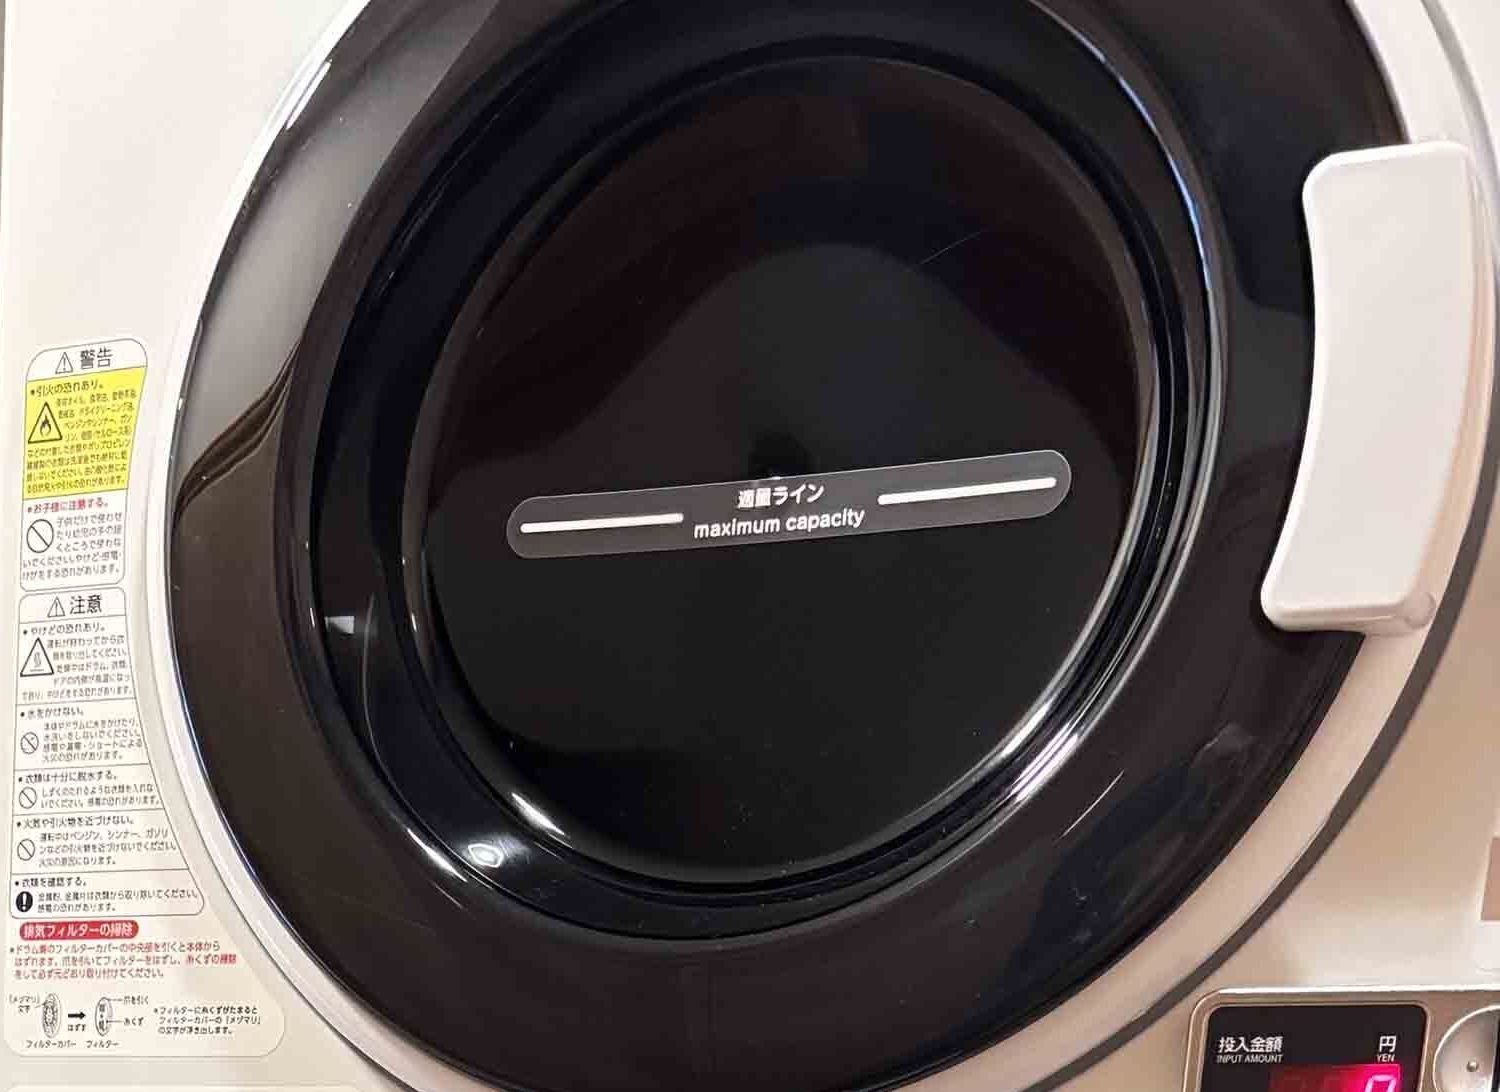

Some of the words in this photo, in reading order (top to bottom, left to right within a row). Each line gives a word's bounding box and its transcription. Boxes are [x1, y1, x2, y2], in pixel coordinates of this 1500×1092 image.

[80, 348, 113, 370] 警告
[737, 482, 824, 509] 適量ライン
[693, 512, 781, 540] maximum
[785, 506, 866, 535] capacity
[70, 595, 102, 615] 注意
[31, 622, 105, 636] やけどの恐れあり。
[22, 877, 87, 889] 衣類を確認する。
[23, 921, 133, 939] 排気フィルターの掃除
[159, 1005, 258, 1015] フィルターに糸くずがたまると
[26, 1040, 77, 1048] フィルターカバー
[86, 1040, 120, 1048] フィルター
[1218, 1035, 1284, 1053] 投入金額
[1379, 1036, 1396, 1053] 円
[1217, 1054, 1242, 1064] INPUT
[1245, 1054, 1284, 1064] AMOUNT
[1377, 1054, 1396, 1063] YEN
